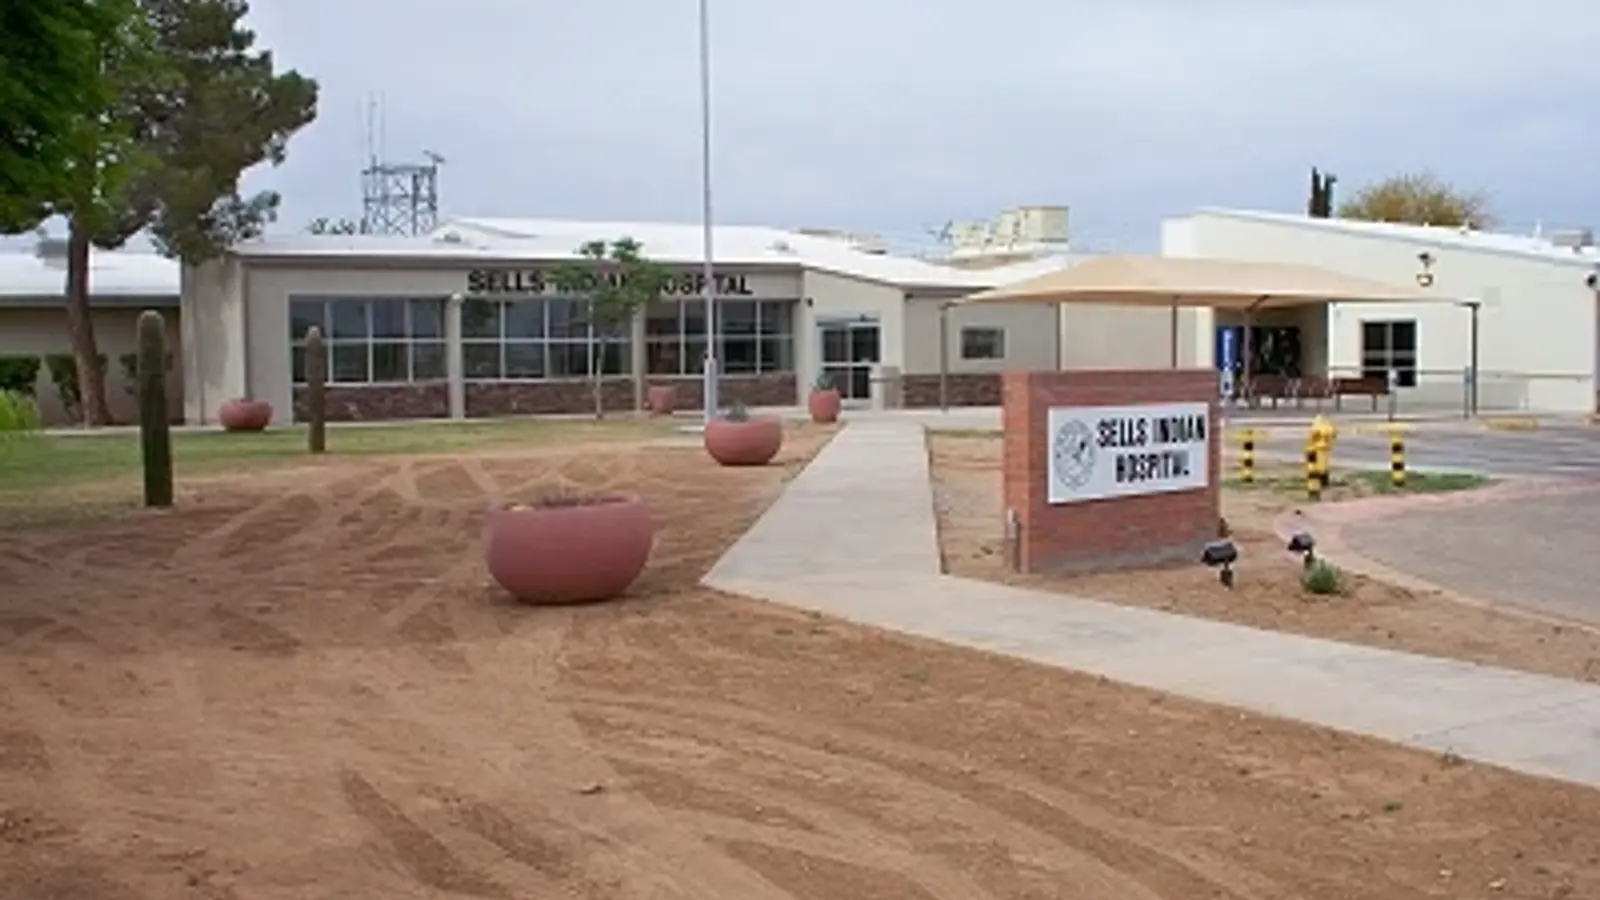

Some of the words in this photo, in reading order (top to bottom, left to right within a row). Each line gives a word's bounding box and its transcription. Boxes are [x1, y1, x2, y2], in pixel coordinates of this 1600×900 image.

[468, 269, 544, 293] SELLS
[649, 272, 753, 297] OSPTAL
[1096, 417, 1149, 449] SELLS
[1152, 413, 1206, 444] INDIAN
[1115, 449, 1190, 484] HOSPITAL
